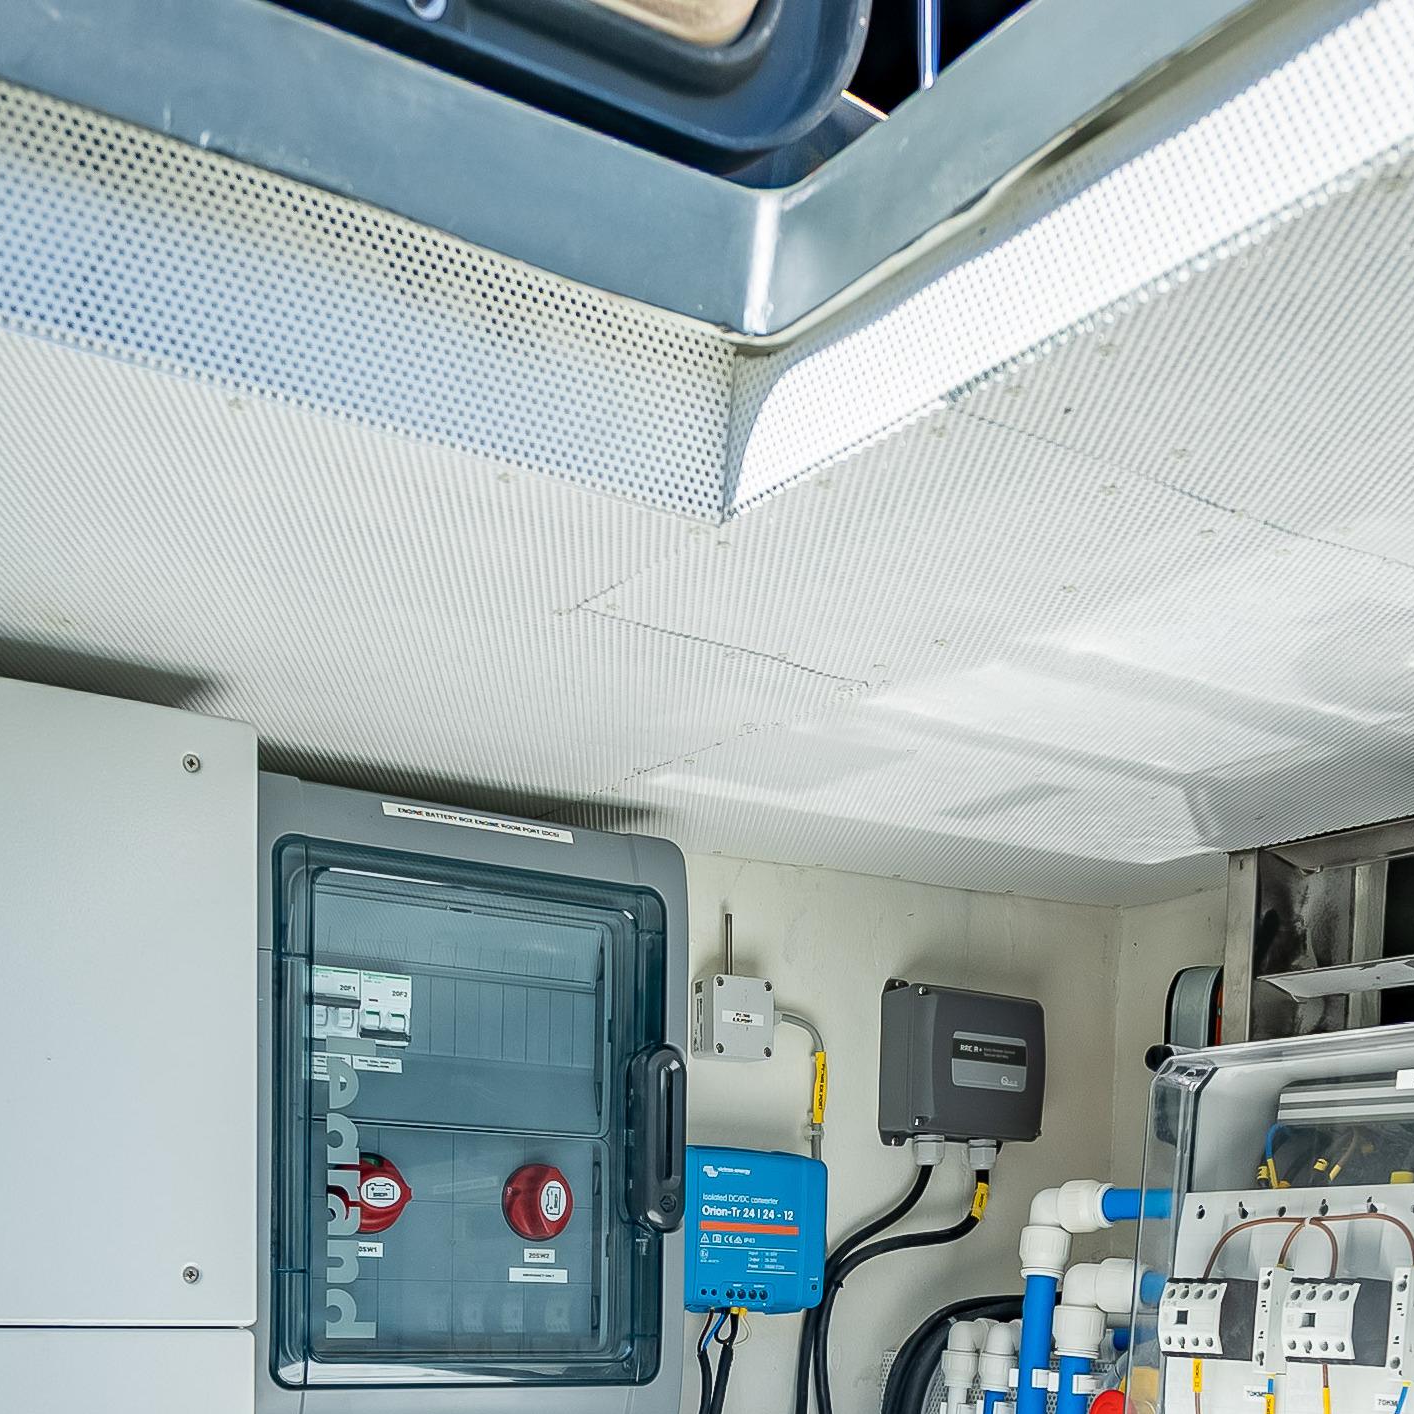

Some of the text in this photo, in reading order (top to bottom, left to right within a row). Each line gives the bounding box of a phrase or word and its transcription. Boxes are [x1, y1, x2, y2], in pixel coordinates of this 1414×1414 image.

[425, 810, 457, 822] BATTERY
[702, 1193, 779, 1205] Isolated DC/DC converter
[702, 1205, 740, 1218] Orion-Tr
[743, 1208, 755, 1218] 24
[762, 1209, 775, 1220] 24
[783, 1211, 794, 1221] 12
